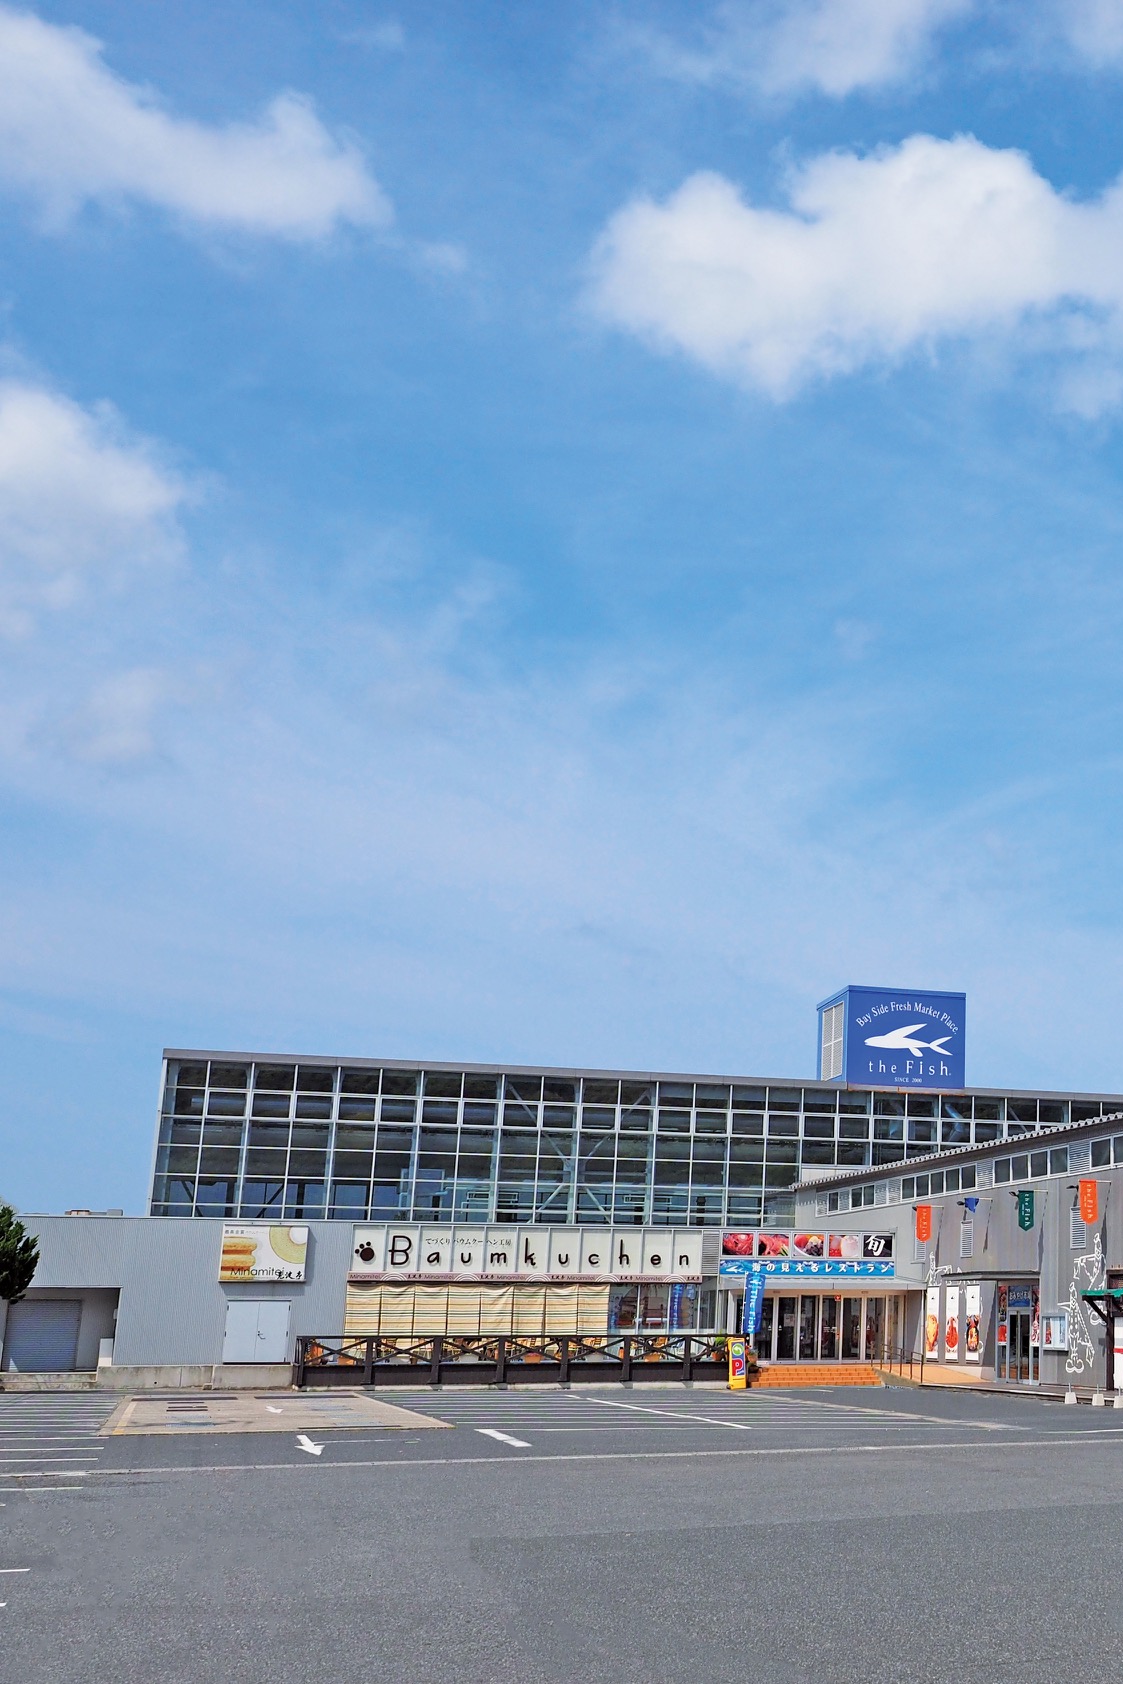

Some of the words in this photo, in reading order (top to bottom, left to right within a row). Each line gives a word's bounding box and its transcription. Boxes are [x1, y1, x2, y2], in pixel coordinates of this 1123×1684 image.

[856, 1013, 872, 1027] Bay
[871, 1005, 889, 1017] Side
[890, 1001, 912, 1011] Fresh
[913, 1002, 941, 1018] Market
[868, 1060, 897, 1073] the
[388, 1235, 689, 1266] Baumkuchen
[866, 1235, 886, 1256] 旬
[230, 1267, 284, 1276] Minamitei
[752, 1263, 889, 1273] 海の見えるレストラン
